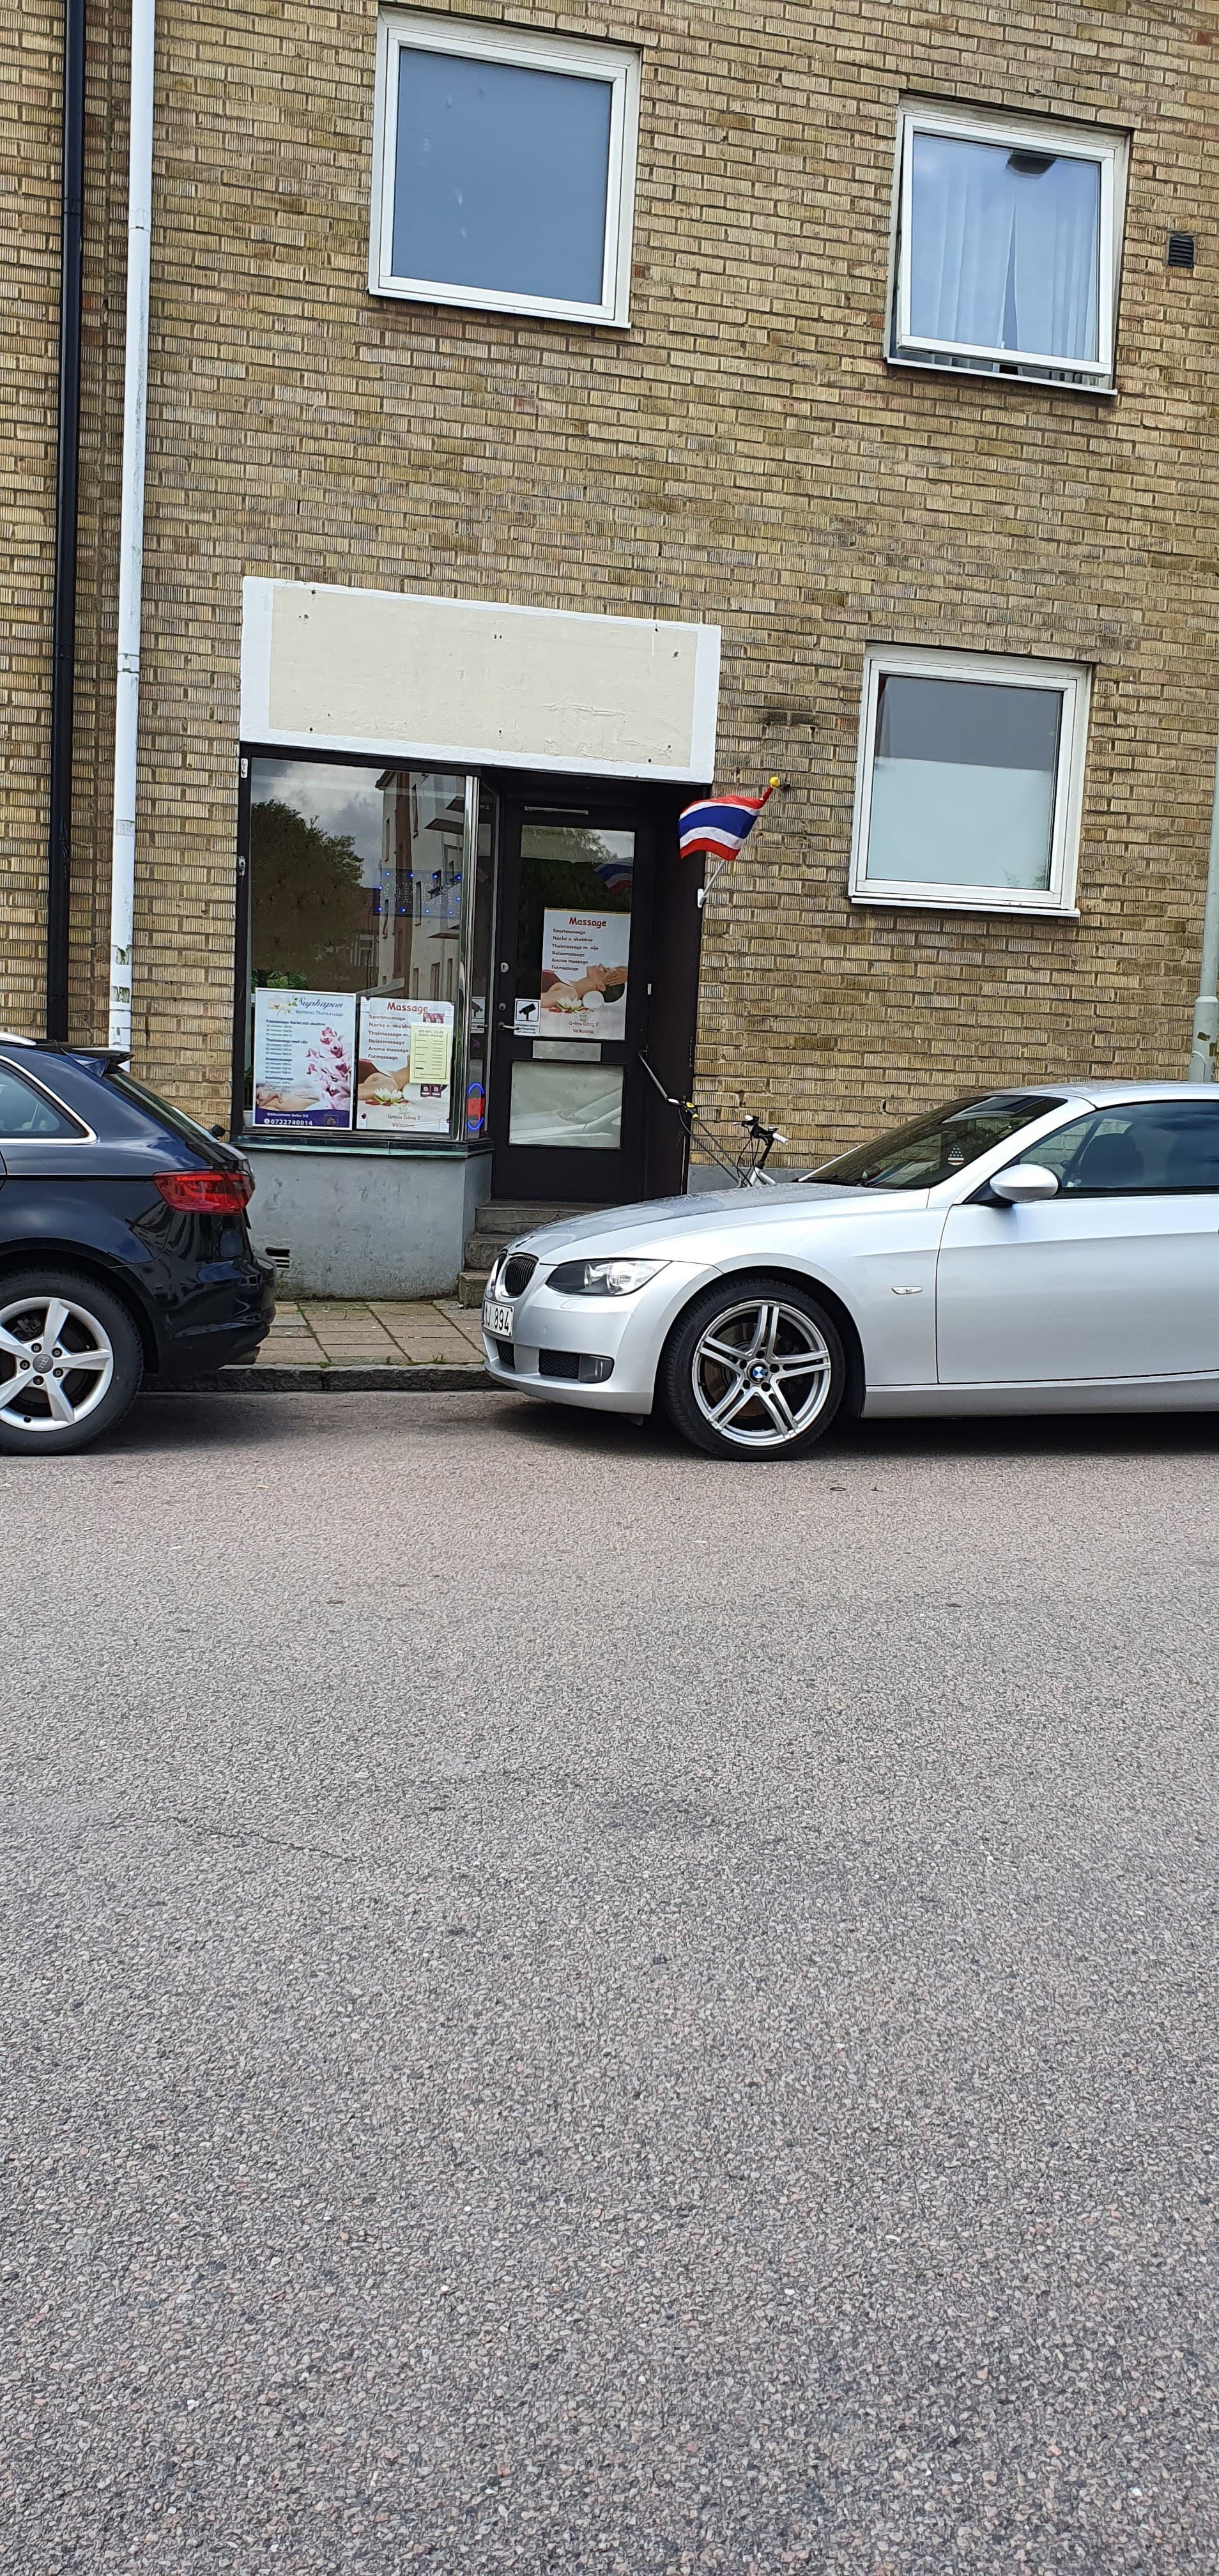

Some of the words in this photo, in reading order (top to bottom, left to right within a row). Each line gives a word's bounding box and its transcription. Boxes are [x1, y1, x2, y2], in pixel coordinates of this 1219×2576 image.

[569, 917, 607, 928] Massage
[387, 1002, 429, 1014] Massage
[494, 1308, 509, 1332] 894
